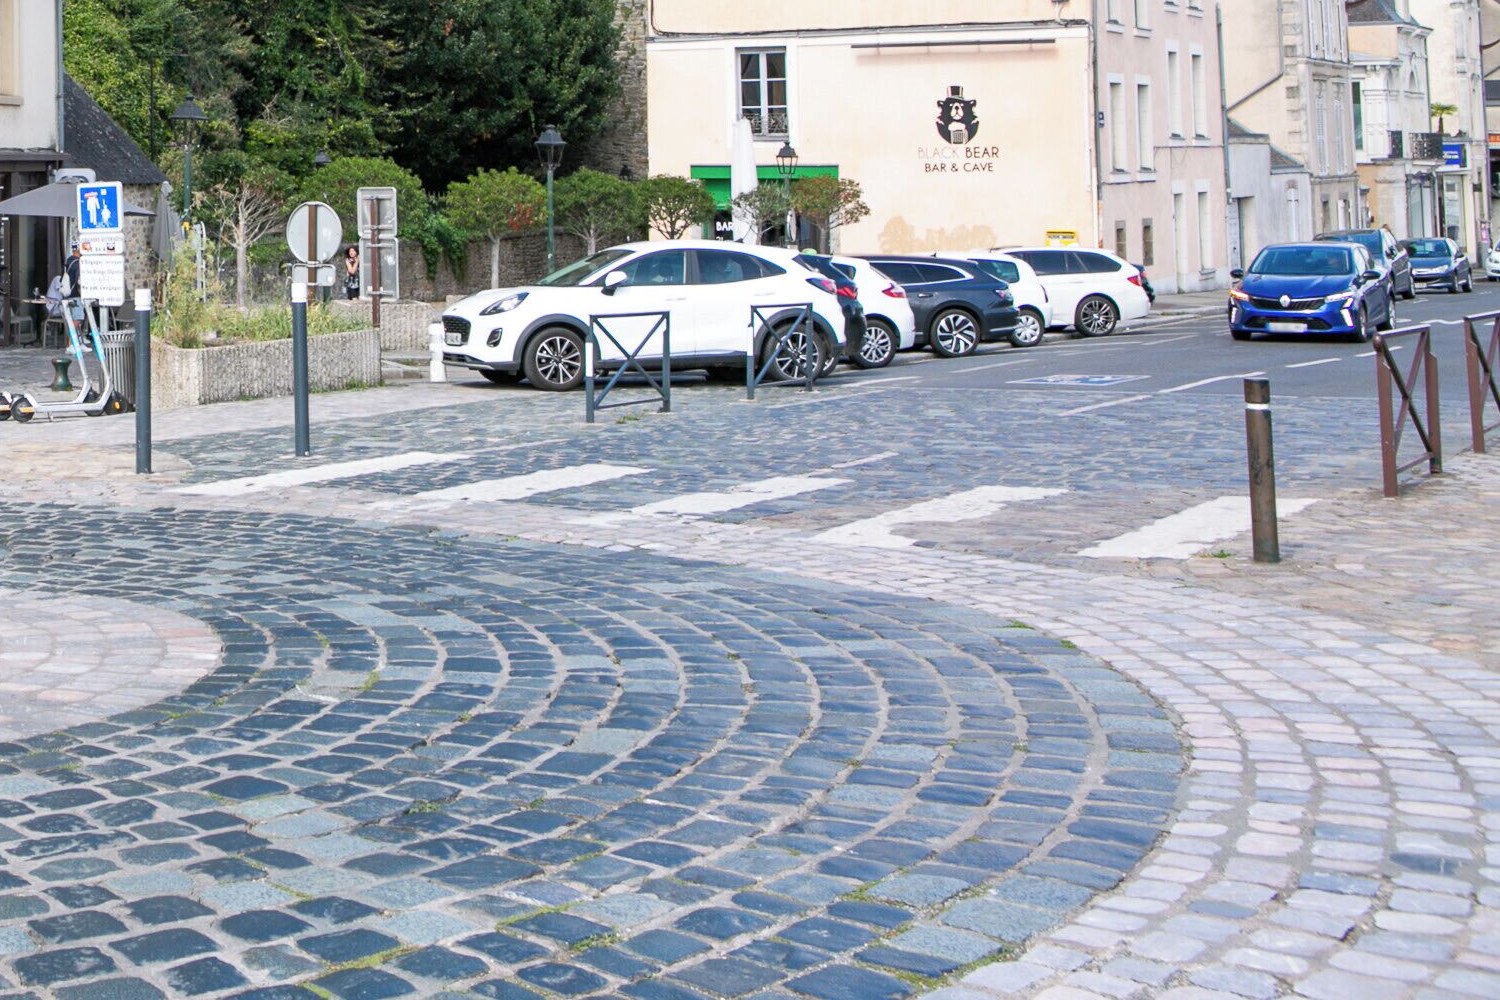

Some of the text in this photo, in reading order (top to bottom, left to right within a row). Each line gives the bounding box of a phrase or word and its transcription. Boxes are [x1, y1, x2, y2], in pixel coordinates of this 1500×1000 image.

[918, 146, 1000, 159] BLACK BEAR
[924, 162, 995, 173] BAR & CAVE
